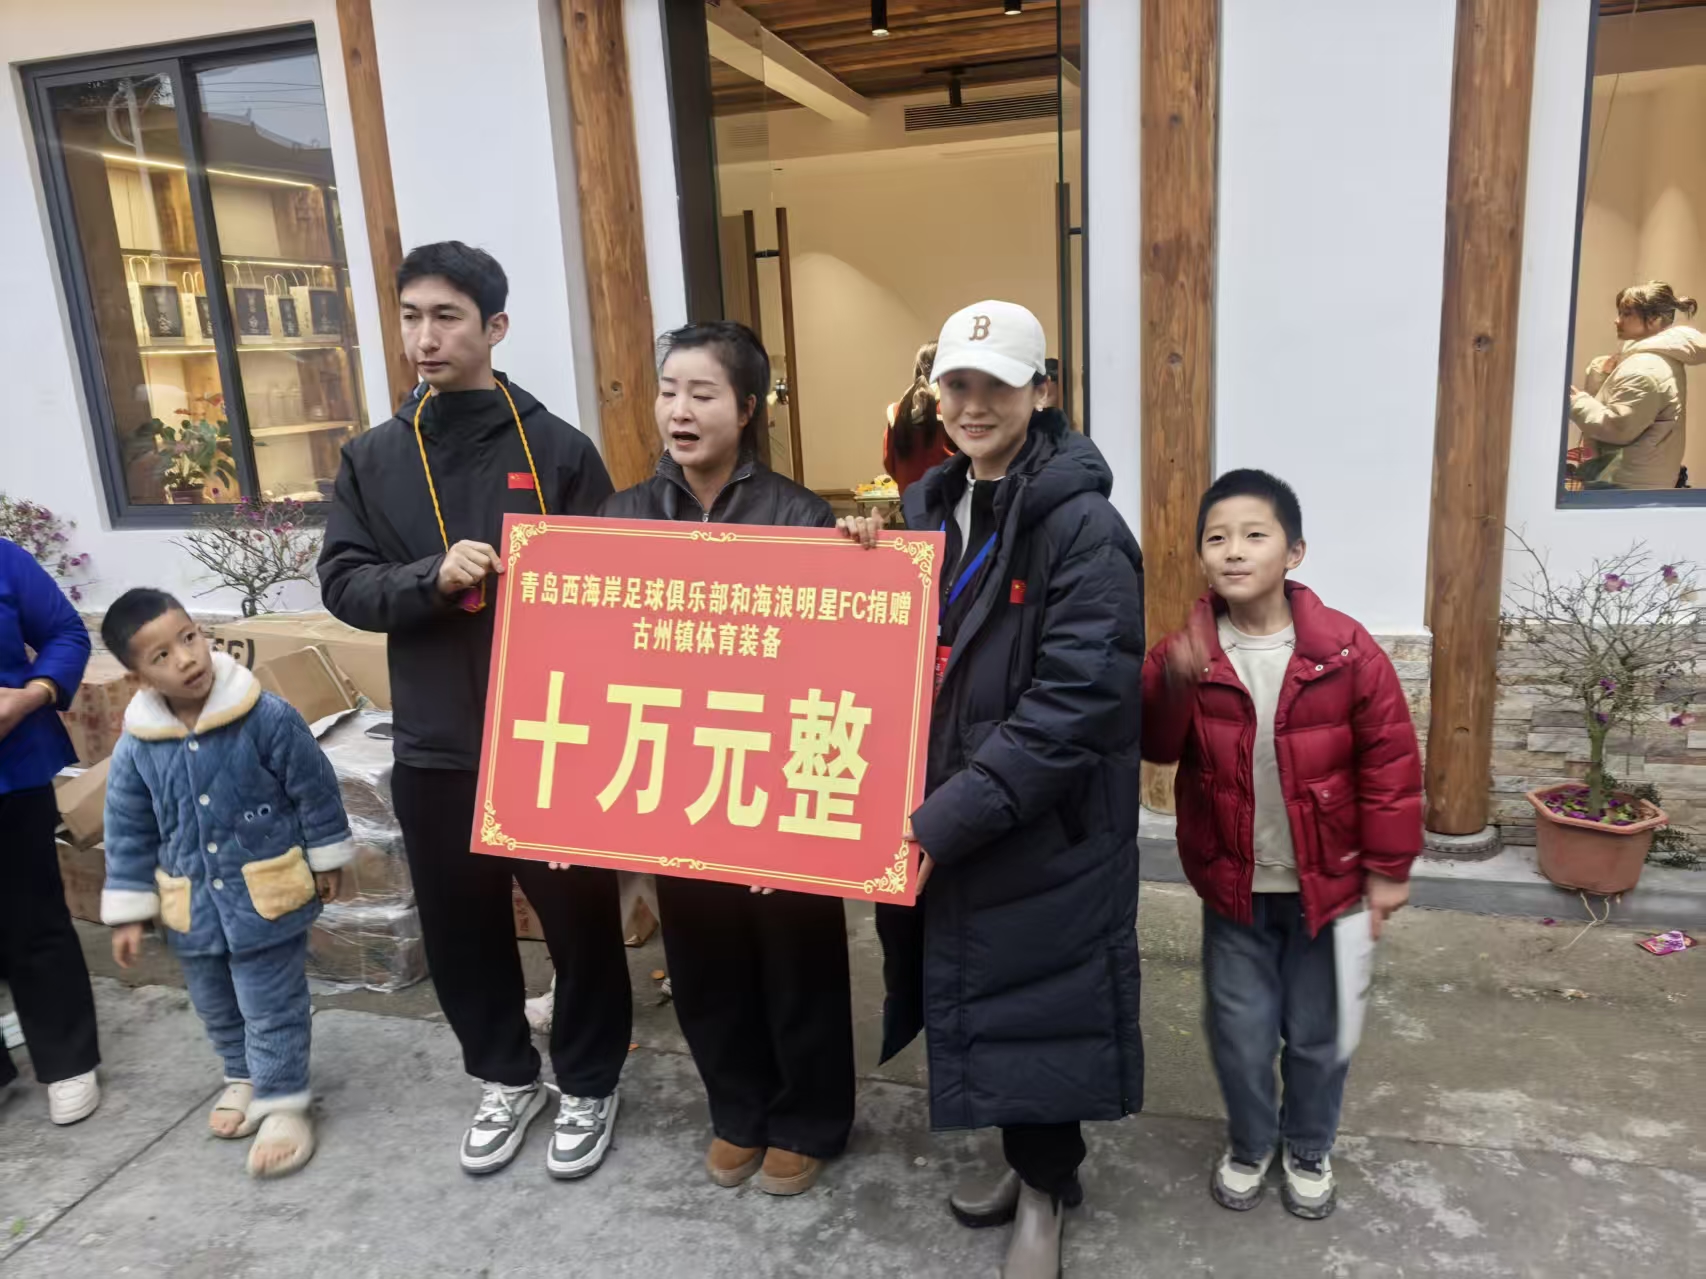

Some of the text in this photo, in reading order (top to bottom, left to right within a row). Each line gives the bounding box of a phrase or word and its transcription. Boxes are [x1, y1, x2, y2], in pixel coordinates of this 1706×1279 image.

[969, 316, 991, 340] B
[521, 572, 912, 625] 青岛西海岸足球俱乐部和海浪明星FC捐赠
[633, 619, 781, 658] 古州镇体育装备
[513, 671, 873, 840] 十万元整
